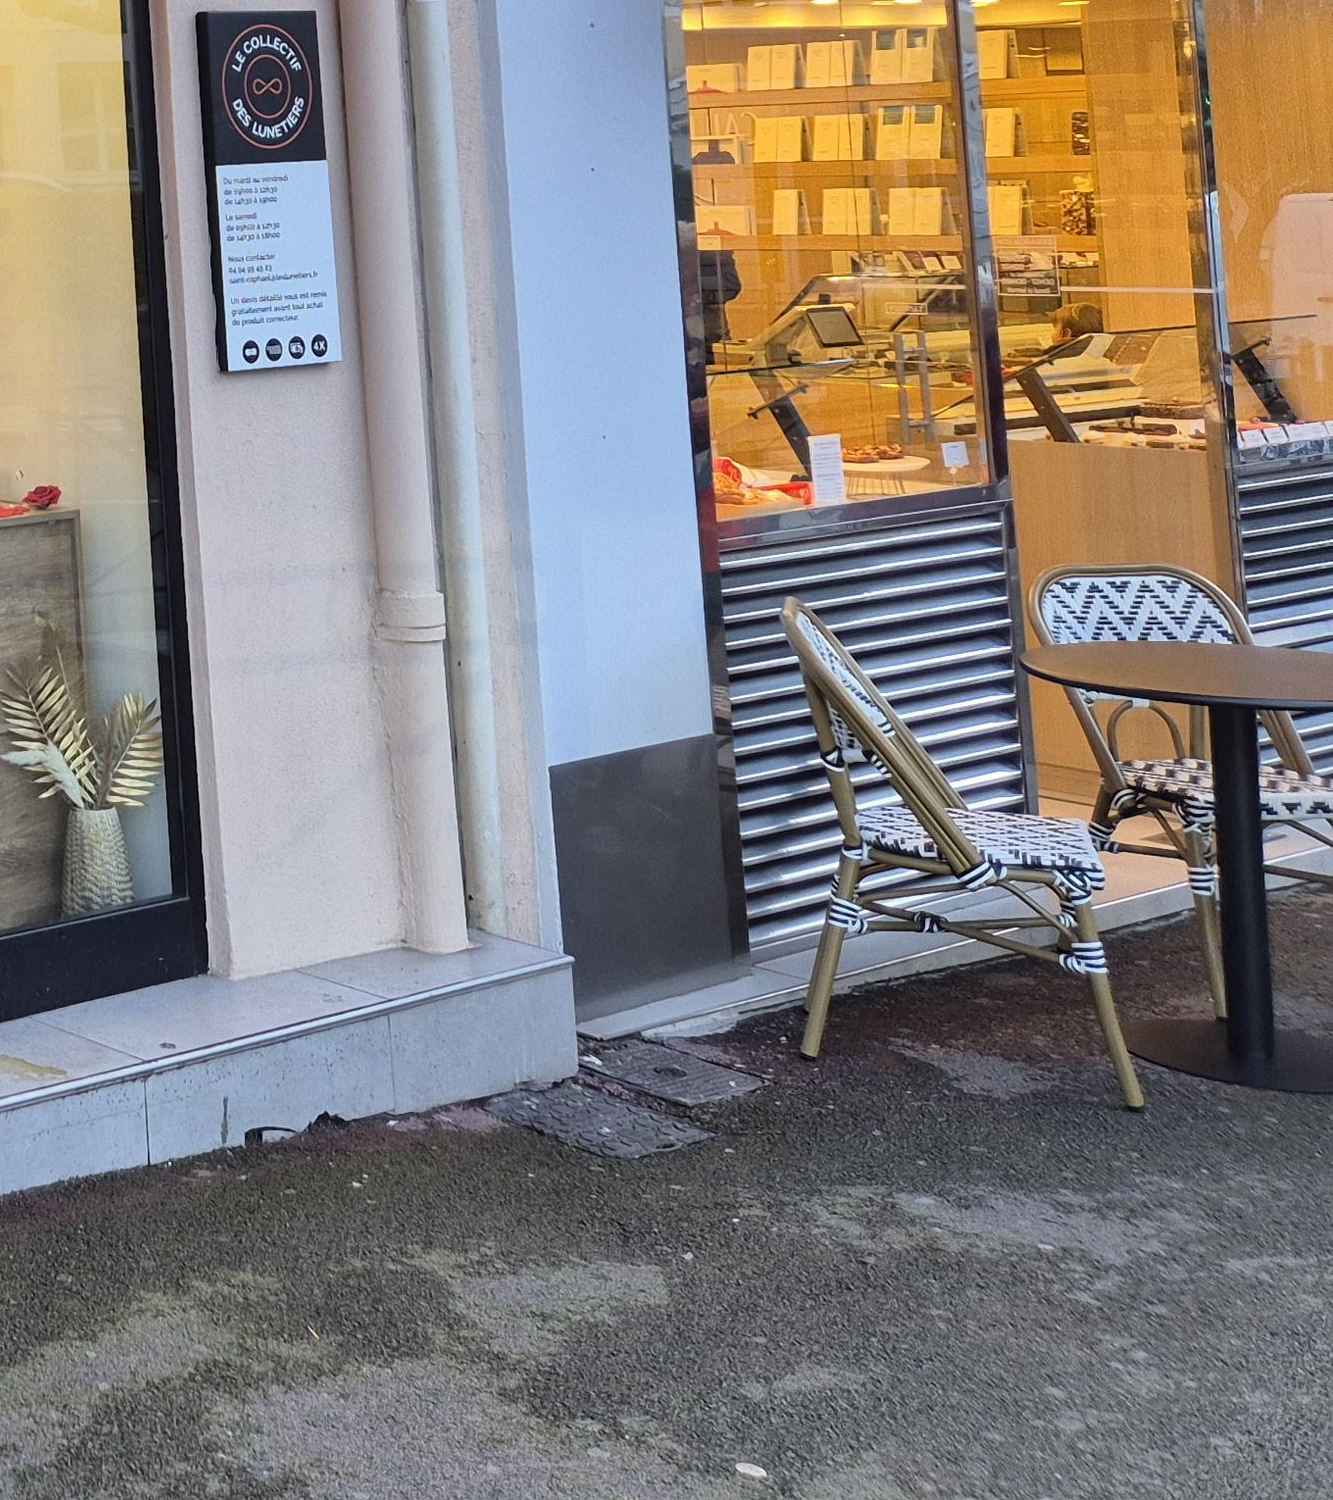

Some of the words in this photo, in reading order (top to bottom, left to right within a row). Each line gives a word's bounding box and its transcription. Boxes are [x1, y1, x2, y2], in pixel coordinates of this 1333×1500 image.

[232, 51, 246, 72] LE
[243, 34, 302, 72] COLLECTIF
[233, 98, 251, 127] DES
[252, 96, 304, 139] LUNETIERS
[313, 340, 326, 351] 4X
